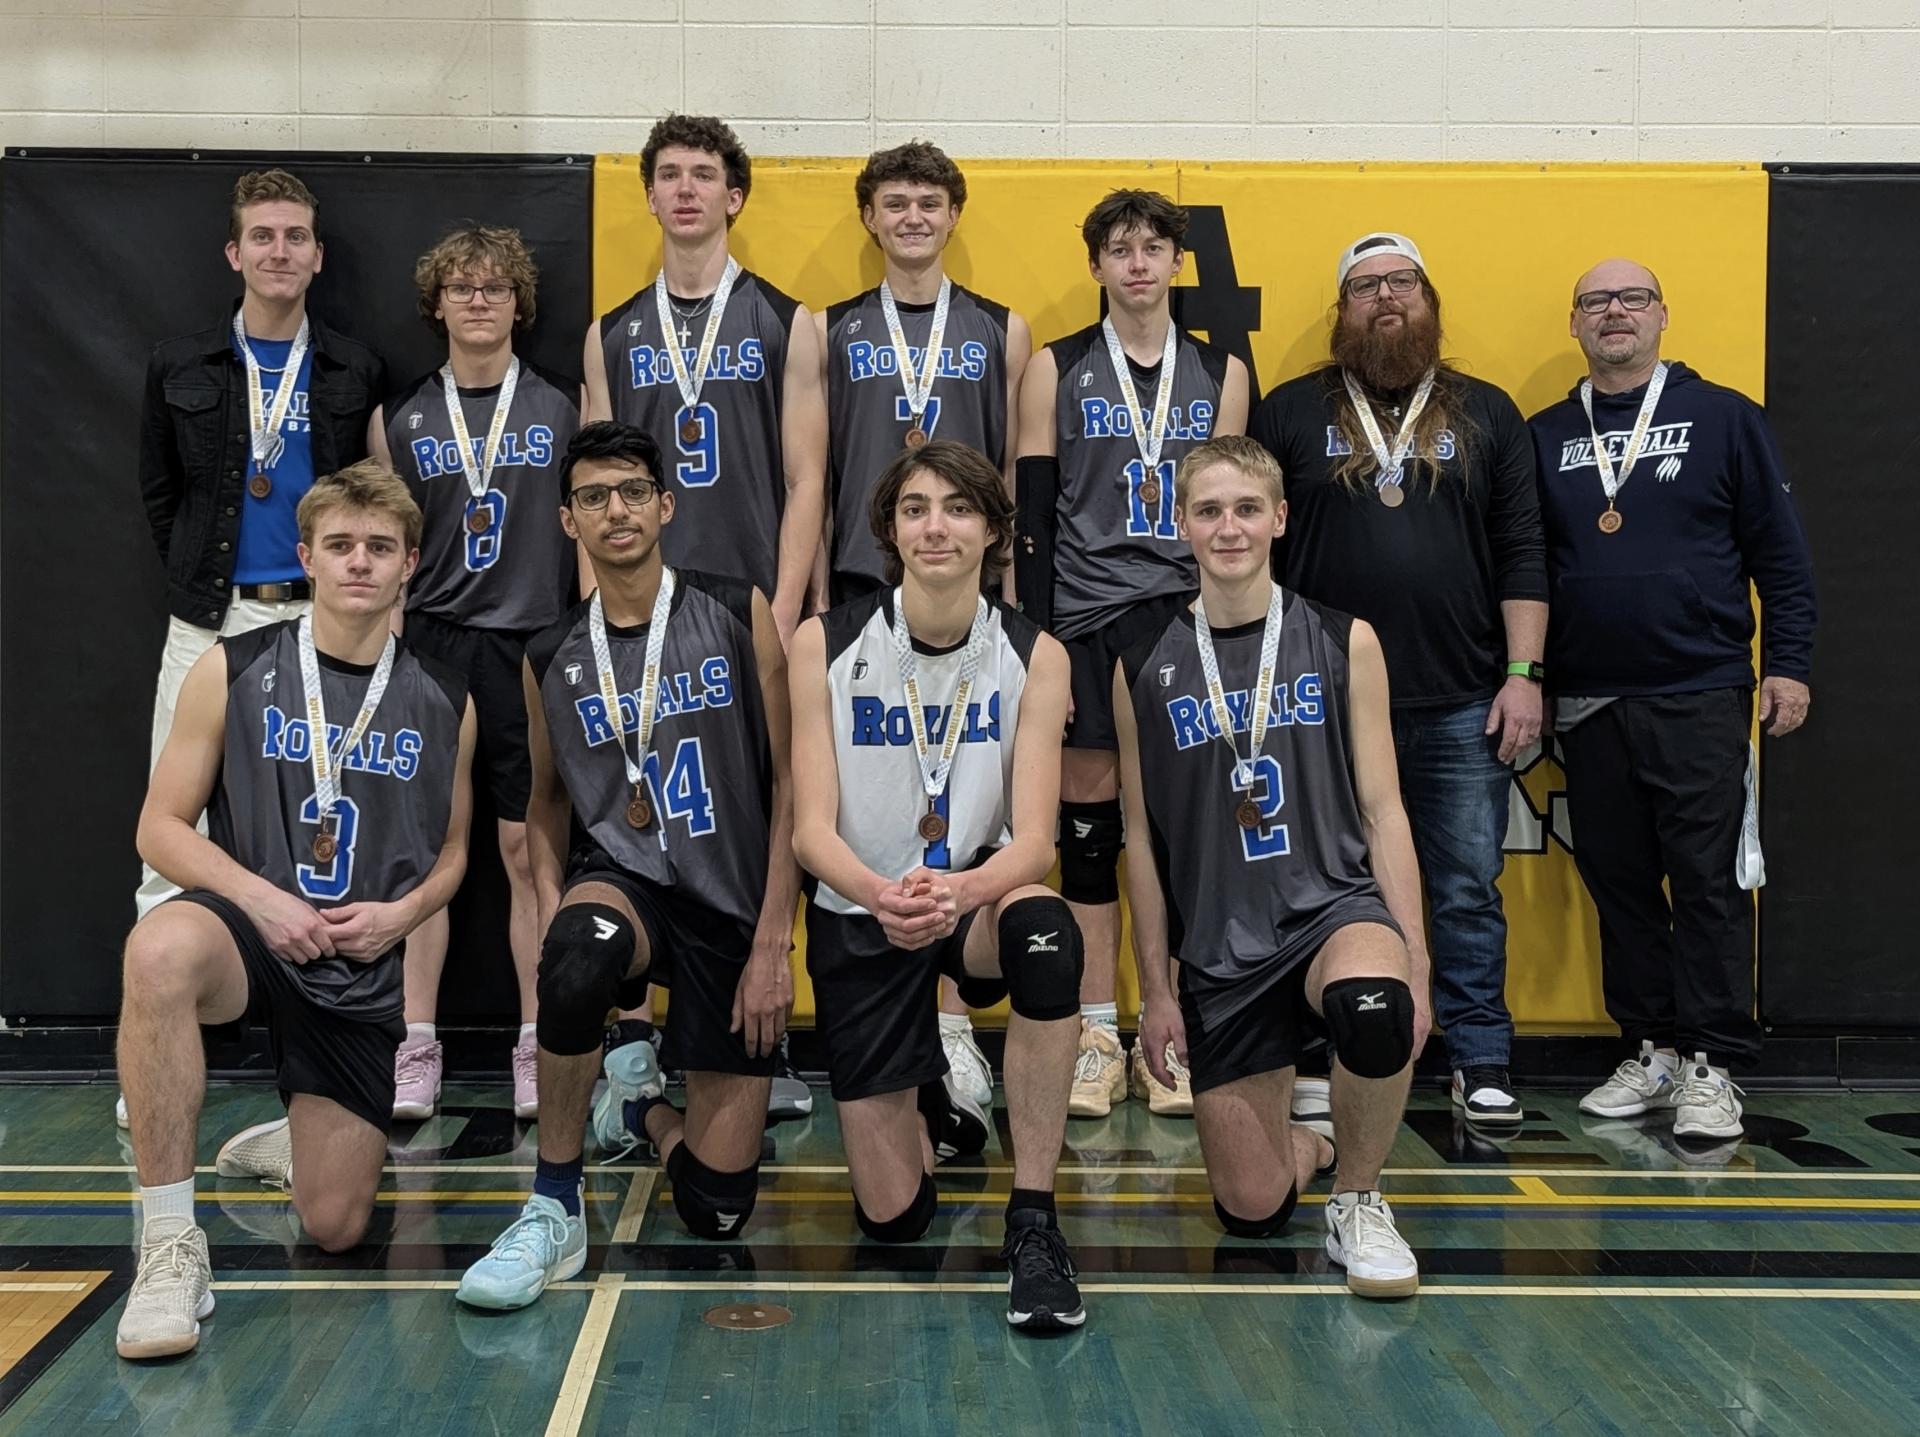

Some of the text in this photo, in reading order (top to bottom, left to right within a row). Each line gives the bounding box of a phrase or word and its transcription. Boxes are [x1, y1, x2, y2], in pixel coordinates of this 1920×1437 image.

[674, 402, 720, 488] 9
[895, 396, 941, 445] 7
[1123, 458, 1178, 540] 11
[463, 488, 507, 572] 8
[645, 663, 655, 688] PLACE
[905, 677, 919, 704] SOUTH
[955, 679, 969, 703] PLACE
[1209, 680, 1223, 705] SOUTH
[309, 696, 320, 720] PLACE
[1230, 754, 1291, 862] 2
[298, 793, 360, 901] 3
